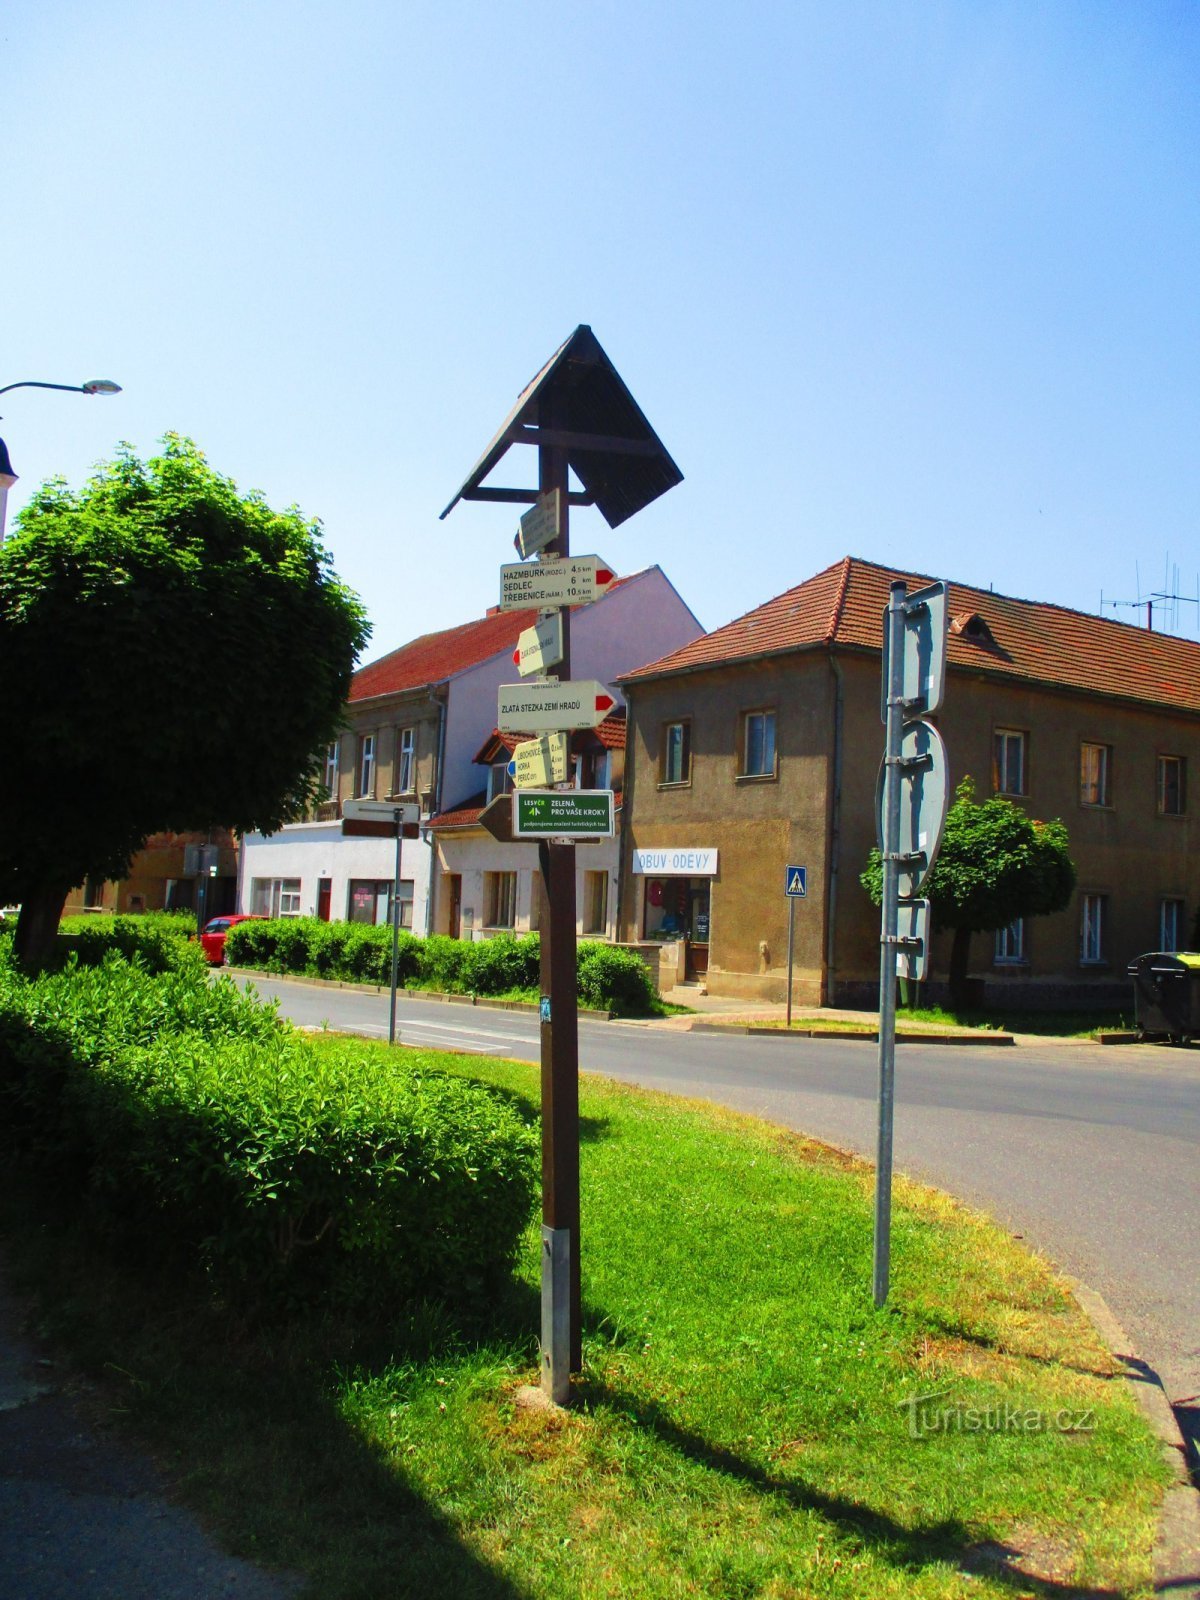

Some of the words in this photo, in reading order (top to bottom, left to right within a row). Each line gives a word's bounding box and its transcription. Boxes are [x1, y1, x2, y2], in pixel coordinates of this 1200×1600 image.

[503, 568, 545, 580] HAZMBURK
[503, 581, 533, 591] SEDLEC
[503, 591, 545, 602] TŘEBENICE
[501, 703, 520, 714] ZLATÁ
[520, 703, 543, 712] STEZKA
[544, 701, 558, 711] ZEMÍ
[559, 699, 581, 710] HRADŮ
[551, 799, 575, 807] ZELENÁ
[551, 808, 564, 816] PRO
[565, 807, 582, 816] VAŠE
[583, 808, 606, 816] KROKY
[640, 854, 667, 869] OBUV
